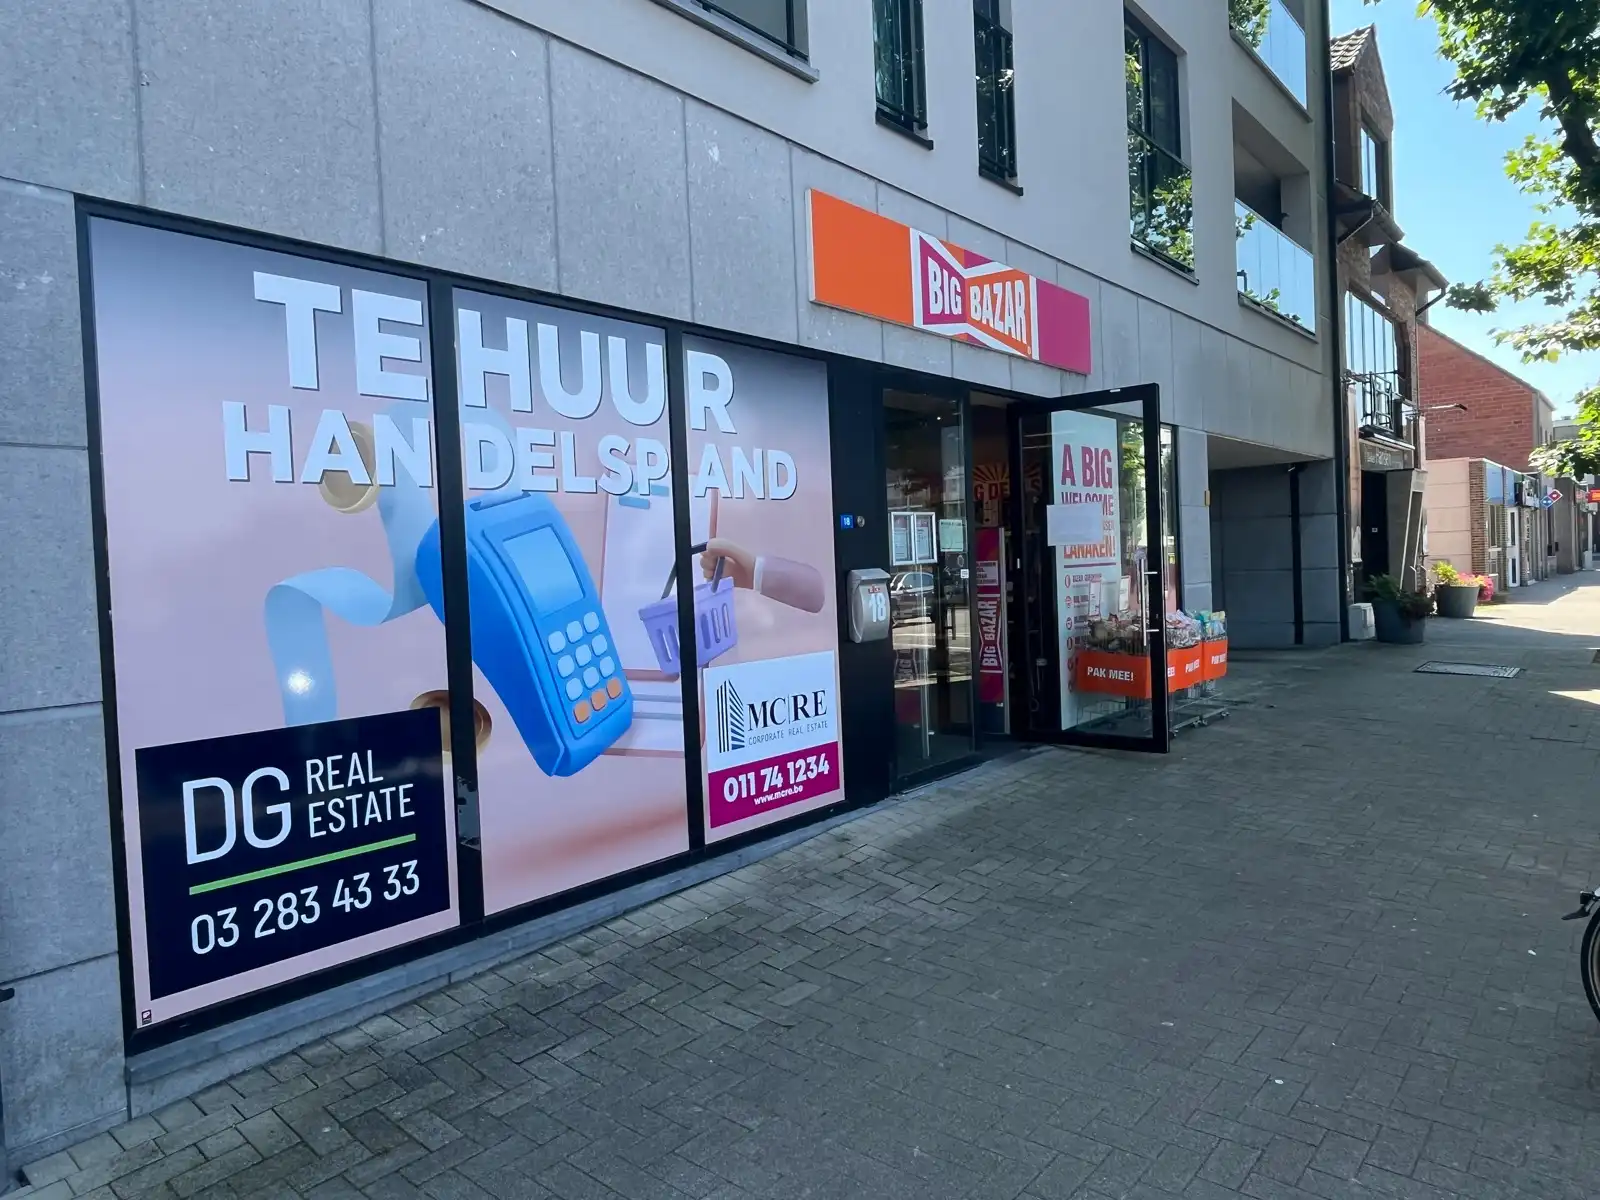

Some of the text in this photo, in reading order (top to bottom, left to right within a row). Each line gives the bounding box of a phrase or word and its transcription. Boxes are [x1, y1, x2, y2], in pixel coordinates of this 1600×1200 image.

[927, 255, 1027, 345] BIG BAZAR
[253, 271, 737, 434] TE HUUR
[1061, 444, 1113, 489] A BIG
[868, 592, 887, 623] 18
[977, 601, 998, 641] BAZAR
[982, 646, 998, 667] BIG
[1087, 666, 1134, 682] PAK MEE!
[748, 720, 828, 745] CORPORATE REAL ESTATE
[306, 750, 384, 794] REAL
[723, 753, 830, 803] 011 74 1234
[182, 767, 292, 865] DG
[308, 783, 415, 838] ESTATE
[191, 860, 420, 955] 03 283 43 33
